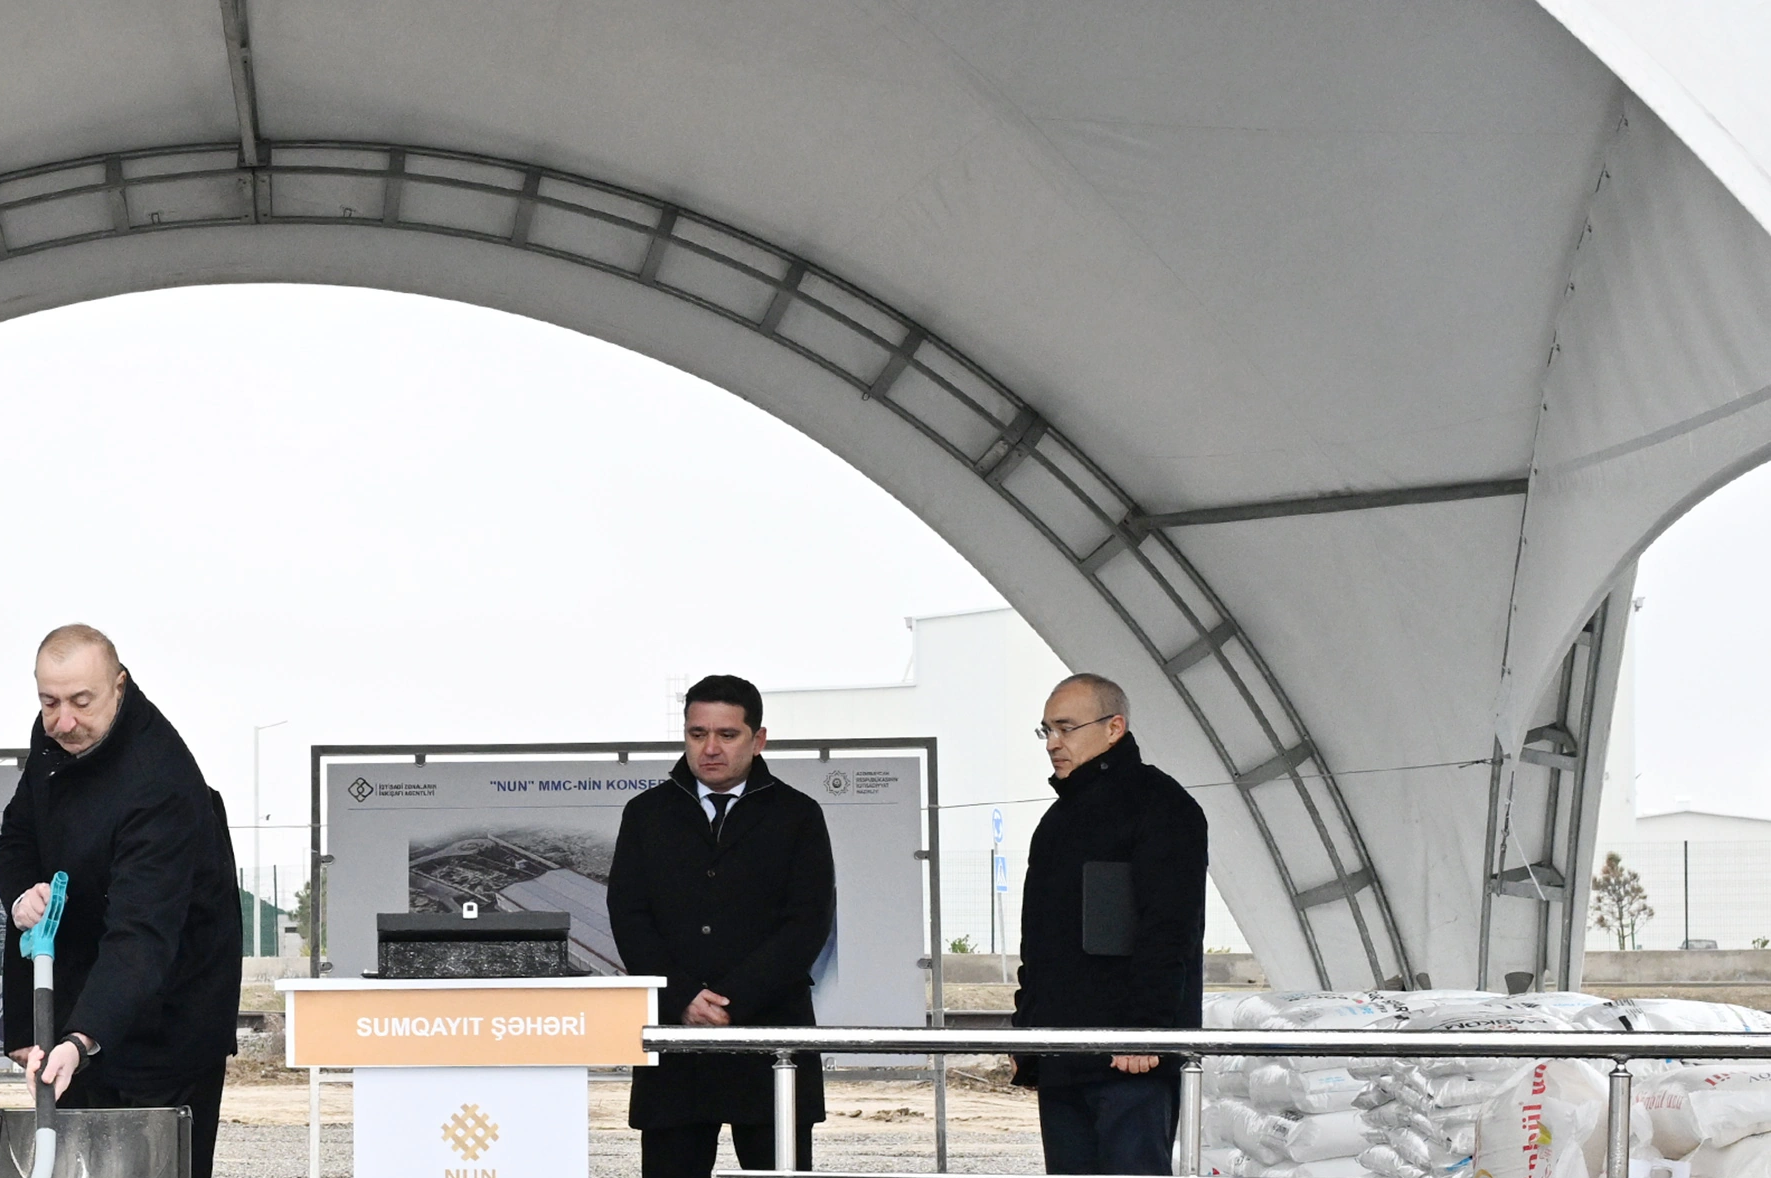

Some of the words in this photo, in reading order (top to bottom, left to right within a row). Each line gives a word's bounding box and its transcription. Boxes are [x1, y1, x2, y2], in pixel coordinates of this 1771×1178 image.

[539, 778, 602, 791] MMC-NİN
[357, 1017, 484, 1037] SUMQAYIT
[491, 1012, 585, 1041] ŞƏHƏRİ
